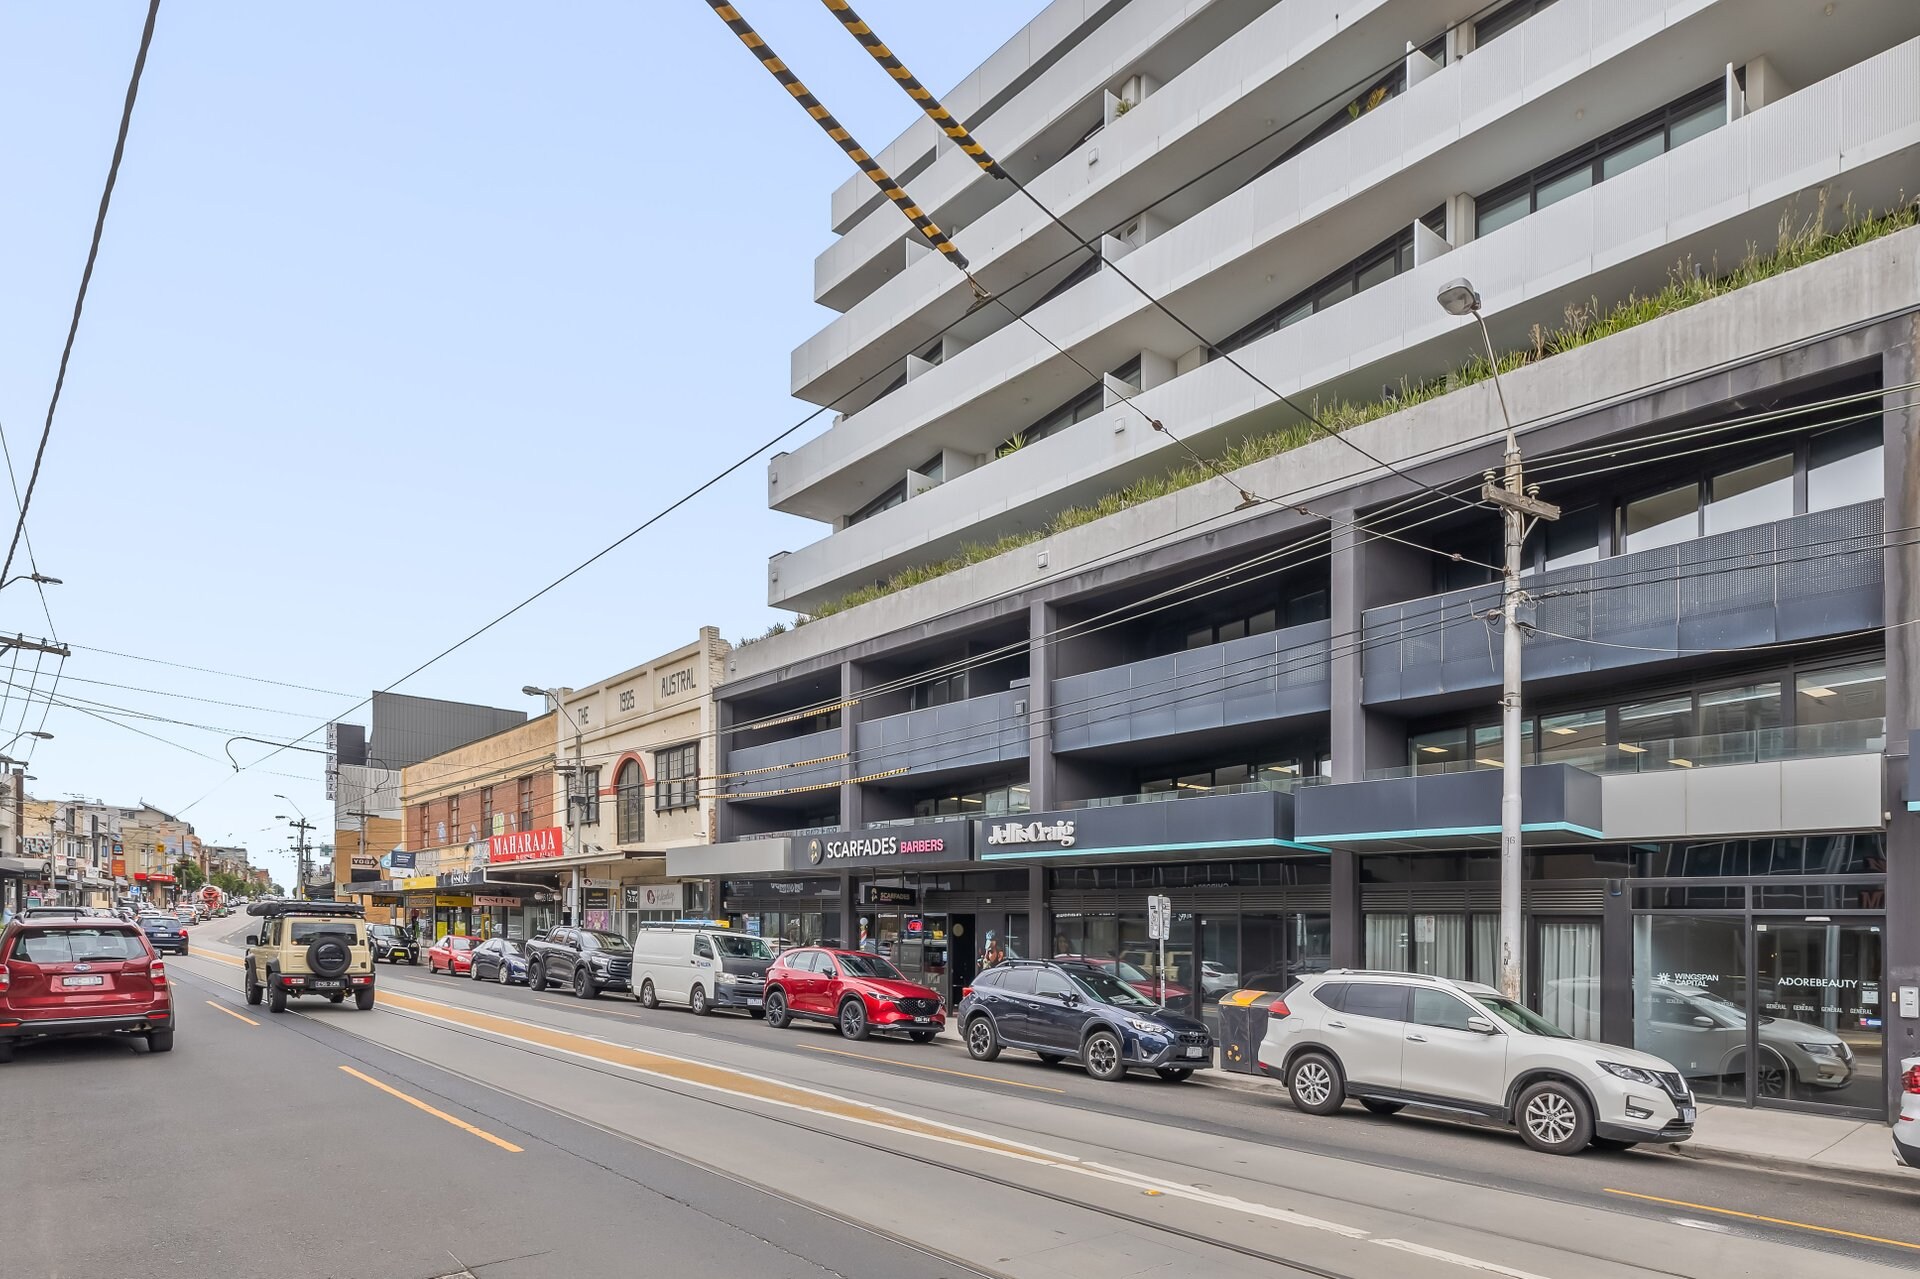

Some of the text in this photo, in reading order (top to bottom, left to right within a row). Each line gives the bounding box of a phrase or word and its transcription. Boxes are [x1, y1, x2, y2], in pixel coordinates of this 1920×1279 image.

[577, 667, 697, 726] THE 1925 AUSTRAL
[493, 830, 556, 856] MAHARAJA
[826, 836, 944, 859] SCARFADES BARBERS
[880, 892, 911, 900] SCARFADES
[1674, 973, 1719, 981] WINGSPAN
[1777, 977, 1858, 988] ADOREBEAUTY
